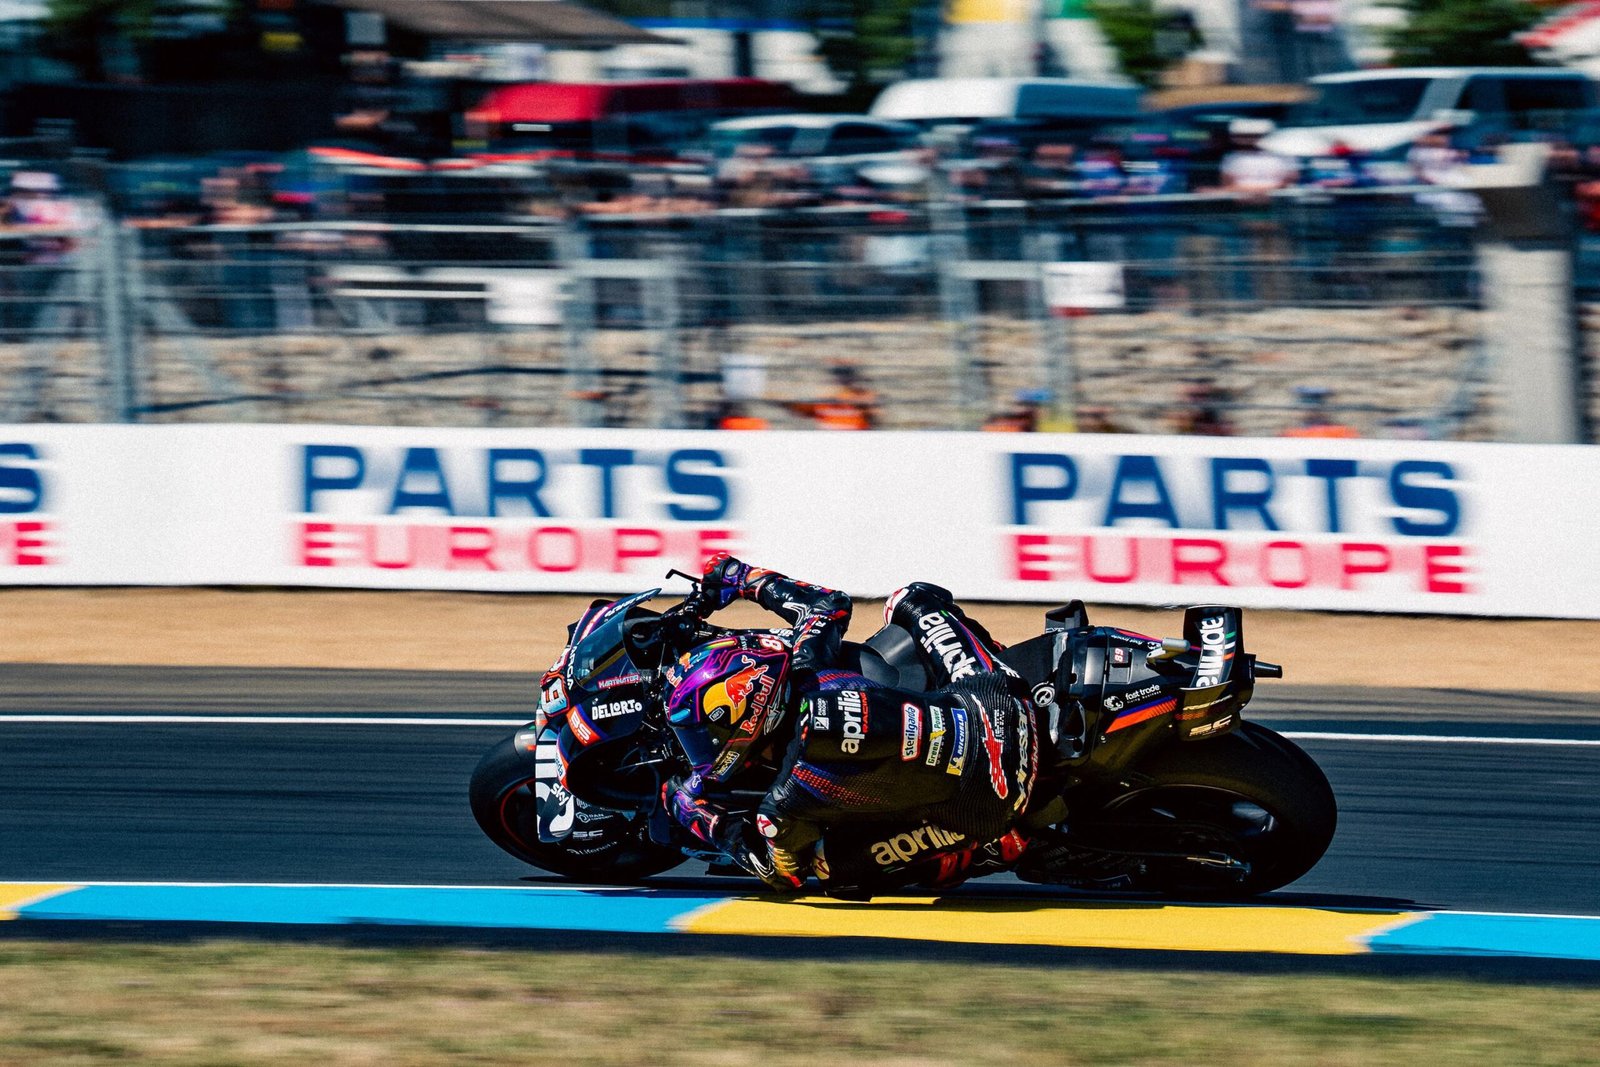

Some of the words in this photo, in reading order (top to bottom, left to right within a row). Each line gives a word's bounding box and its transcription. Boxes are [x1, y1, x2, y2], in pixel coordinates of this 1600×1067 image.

[300, 444, 731, 522] PARTS
[1007, 452, 1461, 537] PARTS
[300, 522, 734, 573] EUROPE
[1008, 533, 1468, 594] EUROPE
[1115, 648, 1124, 662] 89
[1196, 616, 1224, 688] aprilia
[591, 699, 643, 721] DELLORTO
[740, 702, 763, 734] Red
[755, 675, 775, 707] Bull
[860, 692, 869, 733] RACING
[1125, 689, 1139, 701] fast
[1139, 684, 1160, 697] trade
[837, 690, 865, 754] aprilia
[904, 706, 918, 756] sterilgarda
[933, 707, 942, 730] Power
[957, 713, 969, 757] MICHELIN
[928, 741, 939, 765] Green
[551, 782, 570, 806] sky
